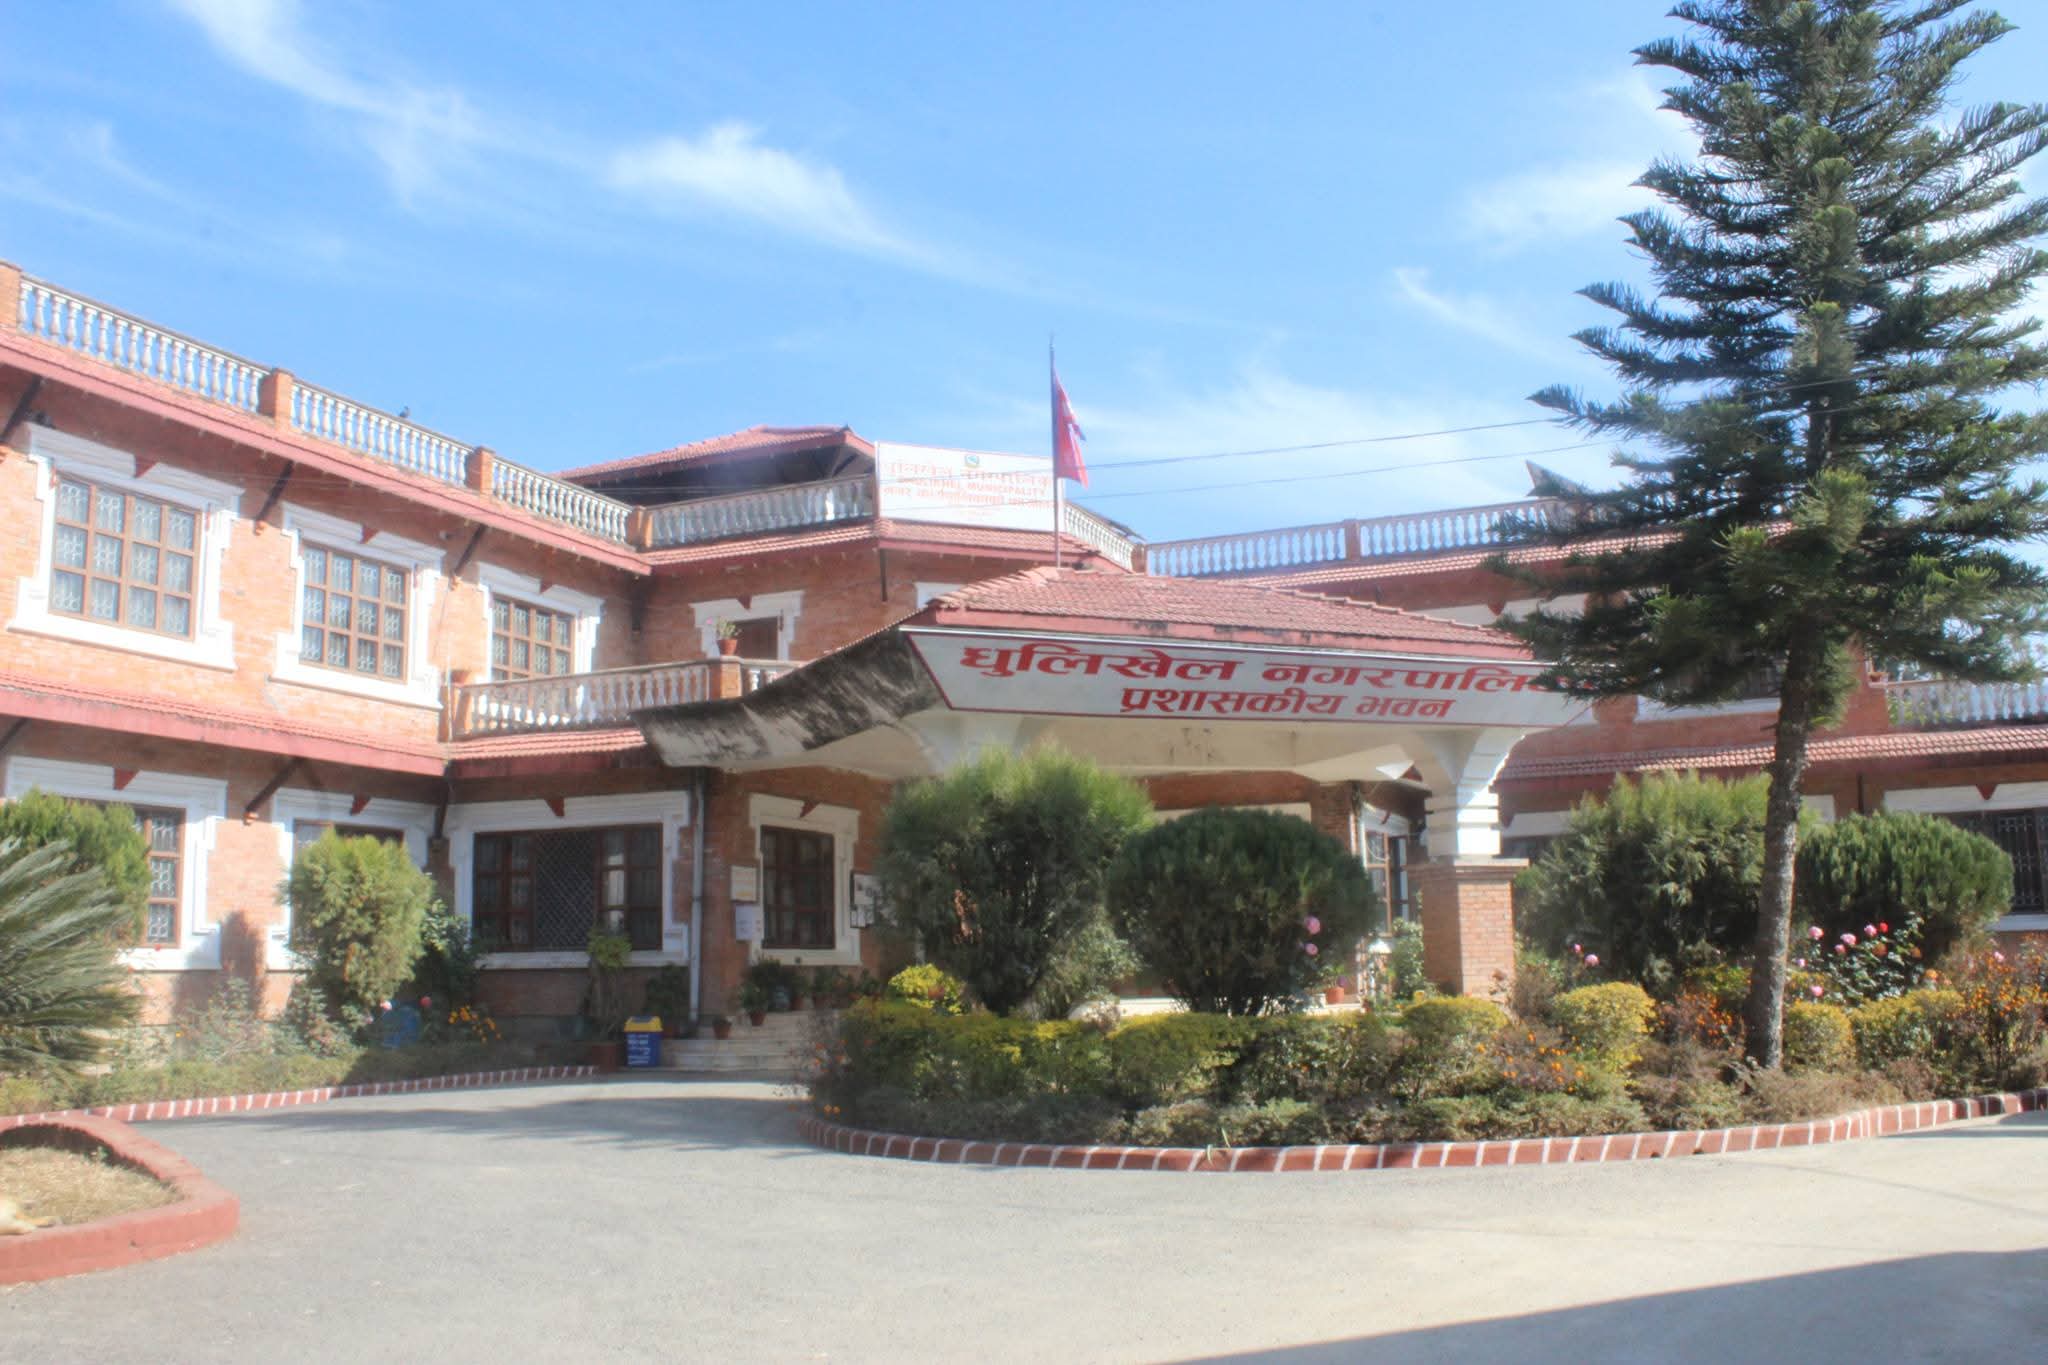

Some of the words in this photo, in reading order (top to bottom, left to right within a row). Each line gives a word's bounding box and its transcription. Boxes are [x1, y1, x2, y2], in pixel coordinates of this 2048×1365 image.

[1262, 663, 1592, 693] नगरपालि
[1119, 687, 1348, 715] प्रशासकीय
[1355, 695, 1457, 718] भवन
